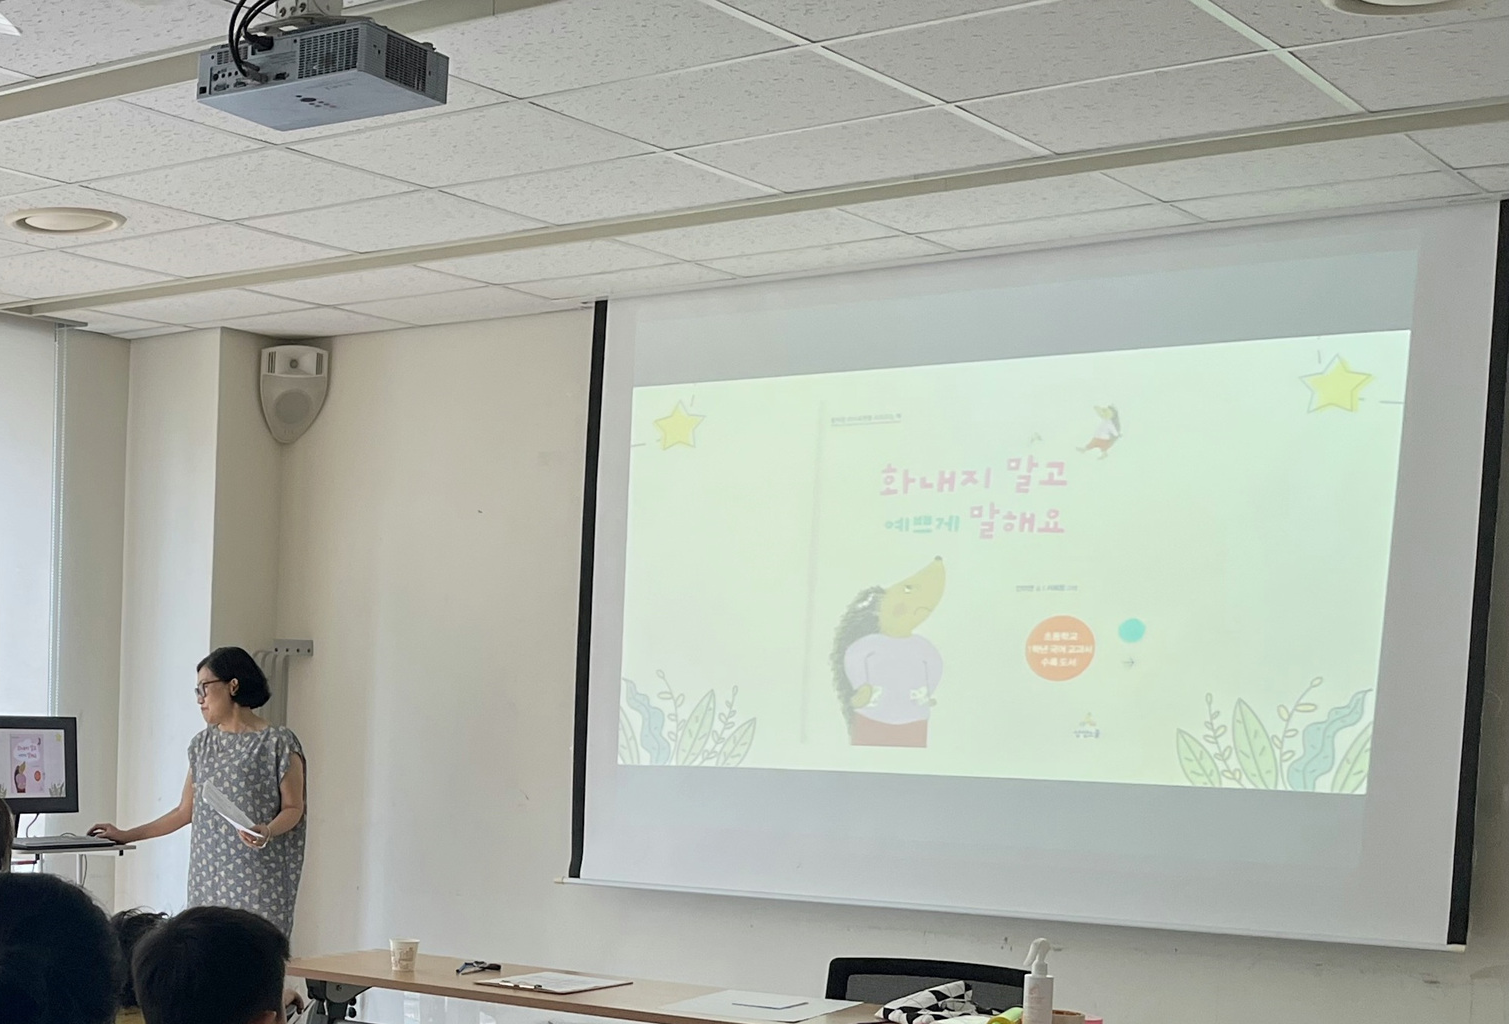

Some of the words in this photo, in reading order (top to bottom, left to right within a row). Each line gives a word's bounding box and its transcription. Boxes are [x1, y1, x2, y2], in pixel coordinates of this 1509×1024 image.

[880, 463, 991, 496] 화내지
[1007, 455, 1068, 493] 말고
[884, 515, 960, 534] 예쁘게
[970, 502, 1065, 539] 말해요
